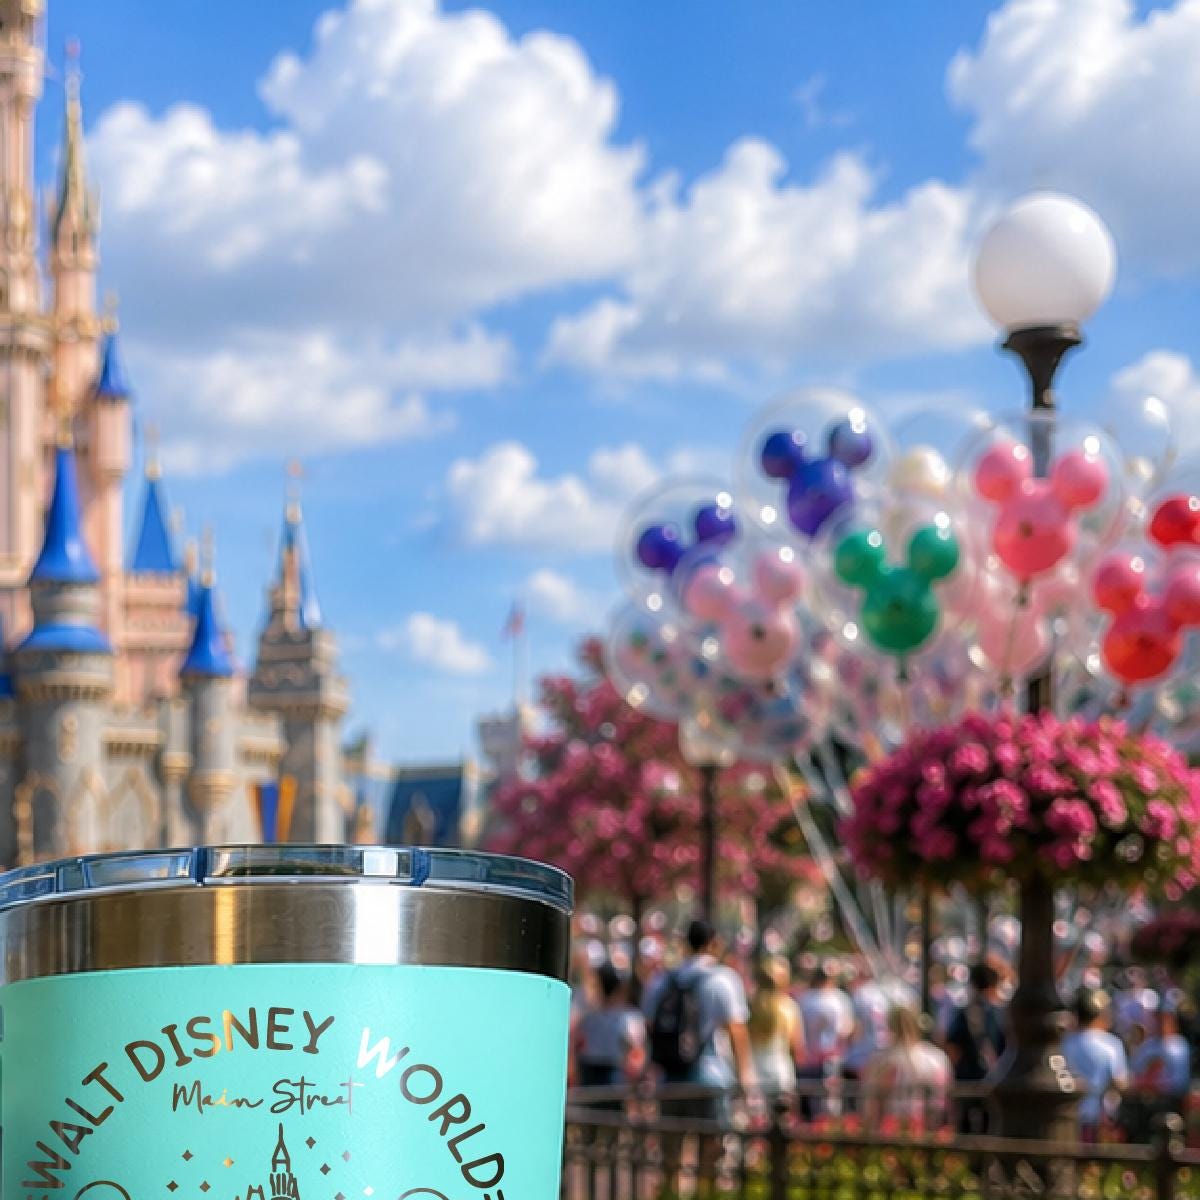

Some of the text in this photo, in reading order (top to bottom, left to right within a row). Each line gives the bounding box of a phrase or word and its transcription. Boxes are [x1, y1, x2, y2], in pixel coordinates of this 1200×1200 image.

[22, 1006, 505, 1190] WALT DISNEY WORLD
[172, 1075, 365, 1115] Main Street
